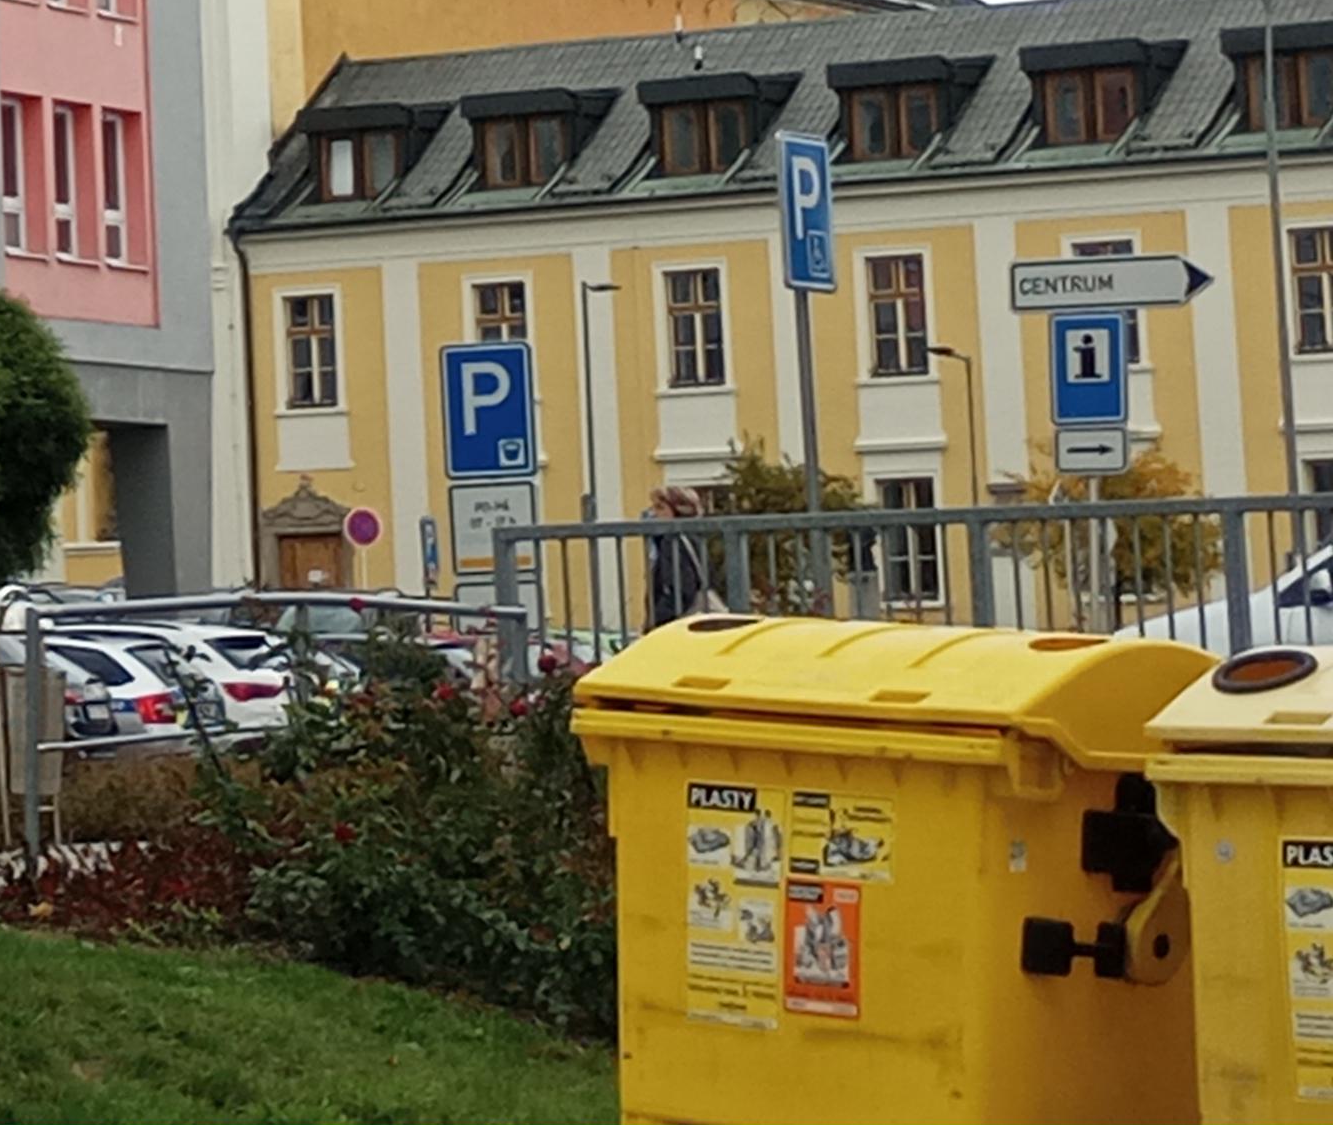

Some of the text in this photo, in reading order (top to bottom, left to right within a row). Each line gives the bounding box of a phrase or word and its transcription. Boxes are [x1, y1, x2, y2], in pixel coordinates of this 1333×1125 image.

[791, 155, 820, 240] P
[1019, 274, 1114, 296] CENTRUM
[460, 361, 511, 435] P
[691, 788, 753, 811] PLASTY
